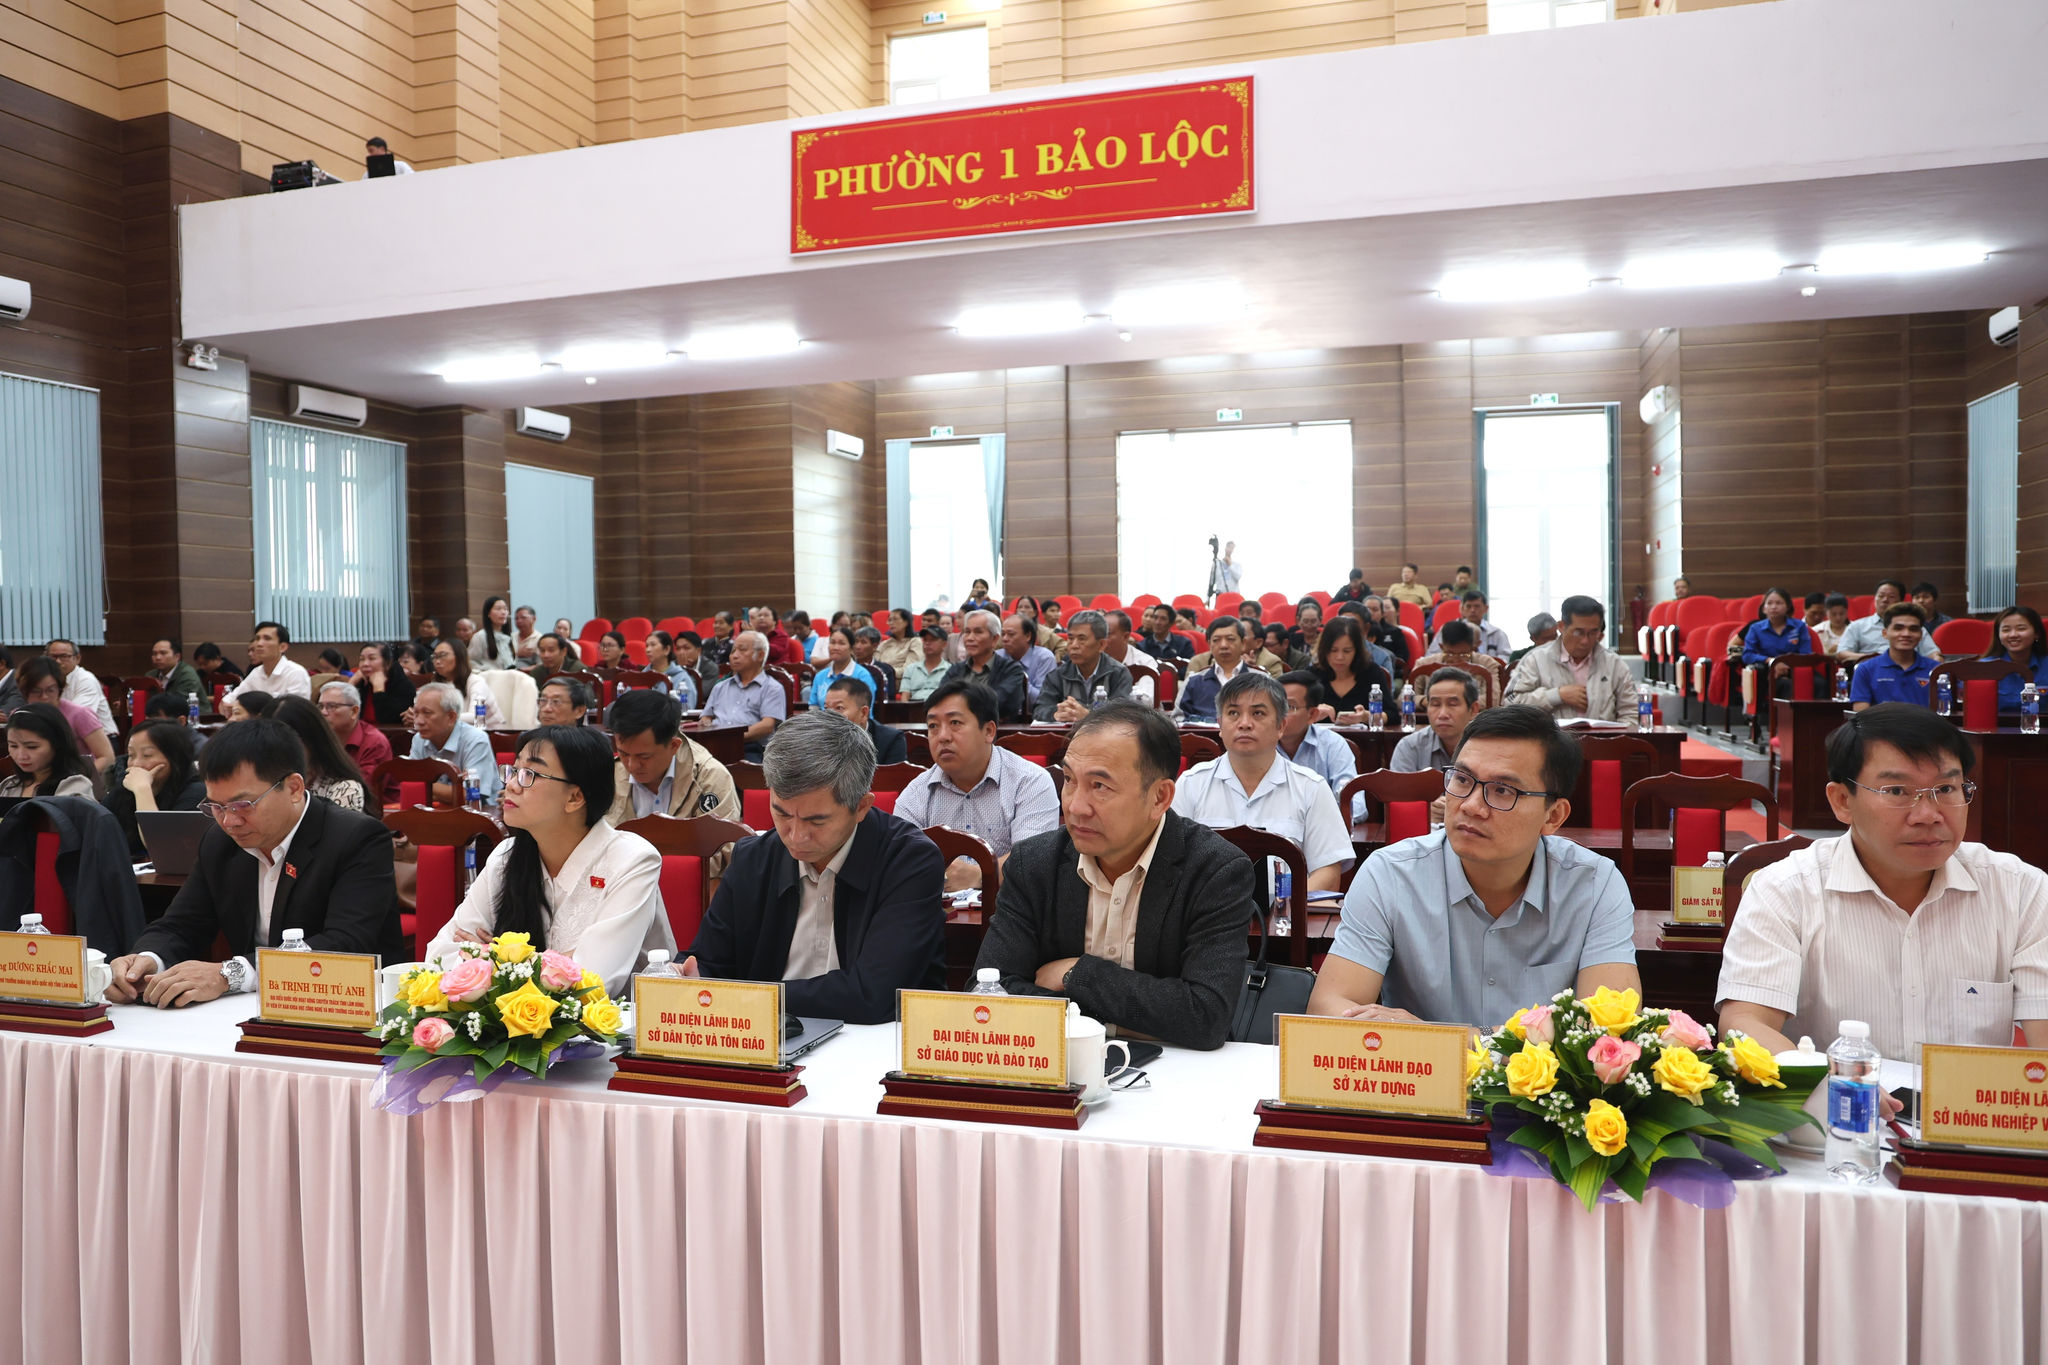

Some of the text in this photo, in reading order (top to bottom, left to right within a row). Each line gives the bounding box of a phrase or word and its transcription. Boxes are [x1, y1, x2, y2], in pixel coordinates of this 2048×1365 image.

[813, 119, 1229, 200] PHƯỜNG 1 BẢO LỘC
[1682, 896, 1700, 906] GIÁM
[1701, 896, 1714, 906] SÁT
[59, 965, 73, 976] MAI
[268, 979, 365, 997] Bà TRỊNH THỊ TÚ ANH
[660, 1012, 751, 1032] ĐẠI DIỆN LÃNH ĐẠO
[648, 1027, 765, 1051] SỞ DÂN TỘC VÀ TÔN GIÁO
[933, 1029, 1036, 1050] ĐẠI DIỆN LÃNH ĐẠO
[917, 1045, 1049, 1071] SỞ GIÁO DỤC VÀ ĐÀO TẠO
[1313, 1055, 1432, 1077] ĐẠI DIỆN LÃNH ĐẠO
[1333, 1074, 1416, 1098] SỞ XÂY DỰNG
[1976, 1089, 1997, 1107] ĐẠI
[2000, 1088, 2030, 1109] DIỆN
[1933, 1106, 1950, 1125] SỞ
[1953, 1109, 1988, 1128] NÔNG
[1991, 1113, 2038, 1134] NGHIỆP
